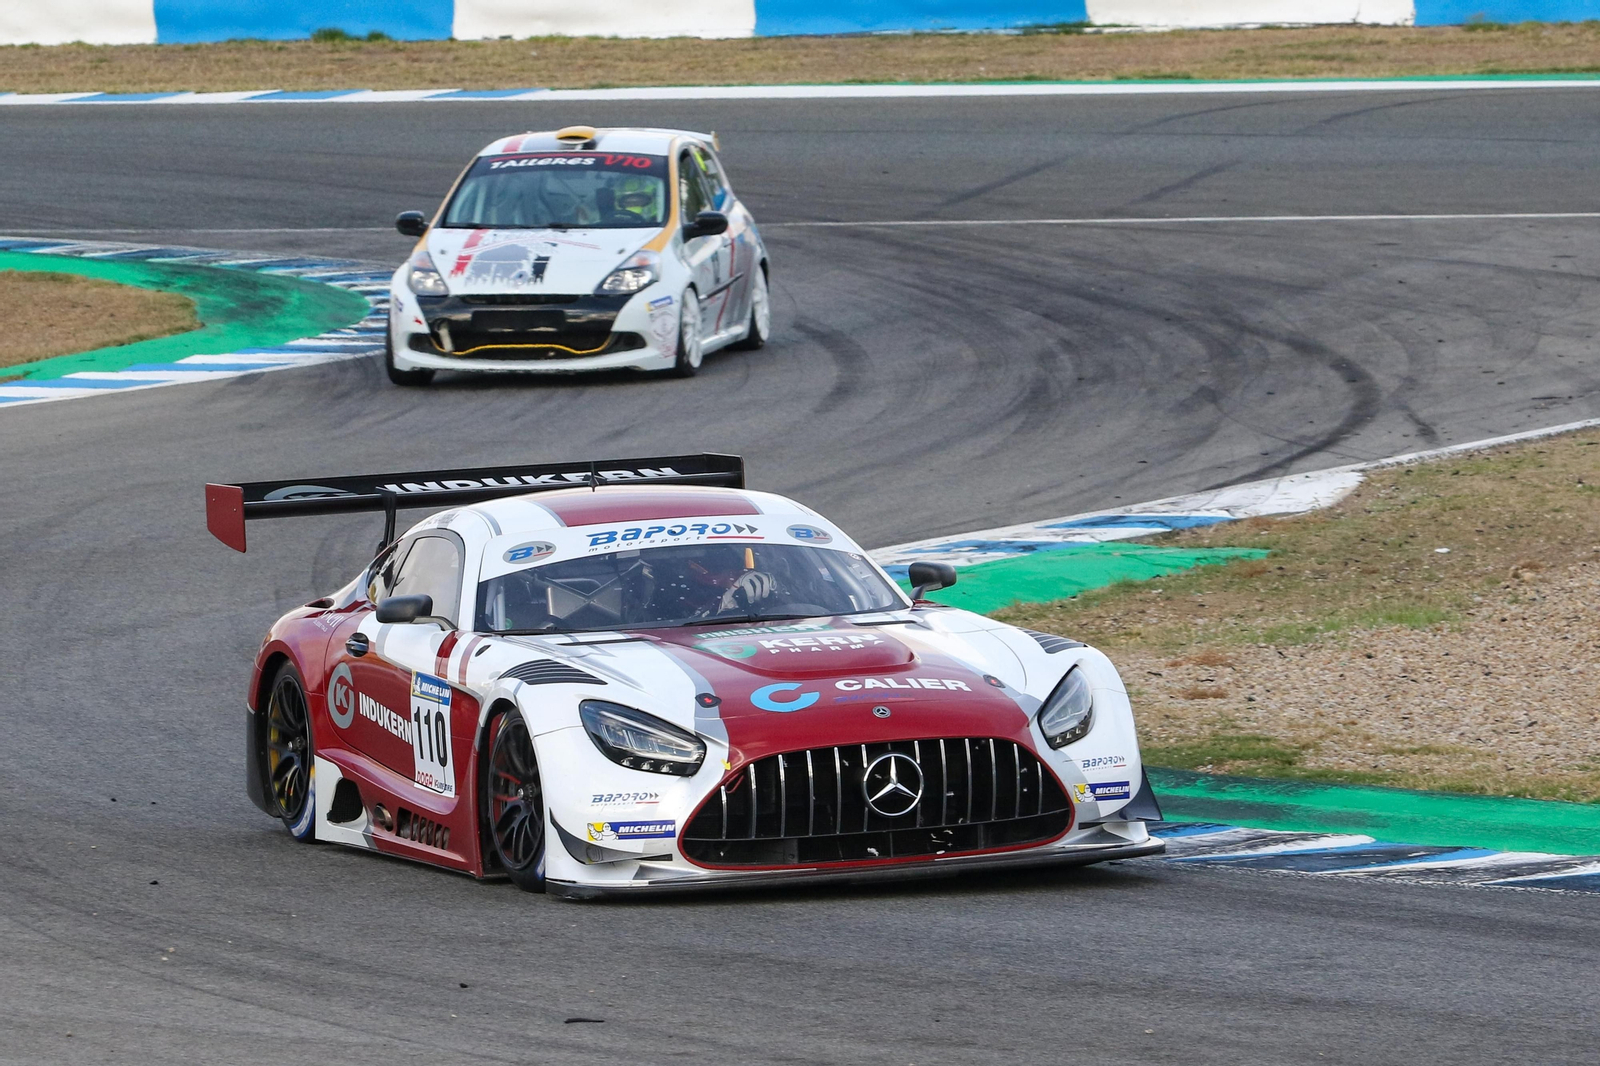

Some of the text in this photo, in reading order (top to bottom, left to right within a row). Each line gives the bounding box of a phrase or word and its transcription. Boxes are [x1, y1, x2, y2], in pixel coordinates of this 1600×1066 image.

[603, 155, 652, 168] V10
[699, 625, 823, 639] FINISHER
[758, 634, 879, 648] KERN
[420, 682, 450, 699] MICHELIN
[834, 677, 973, 692] CALIER
[359, 691, 412, 745] INDUKERN
[414, 706, 447, 767] 110
[416, 770, 434, 788] DOGA
[1096, 786, 1129, 794] MICHELIN
[619, 824, 675, 833] MICHELIN
